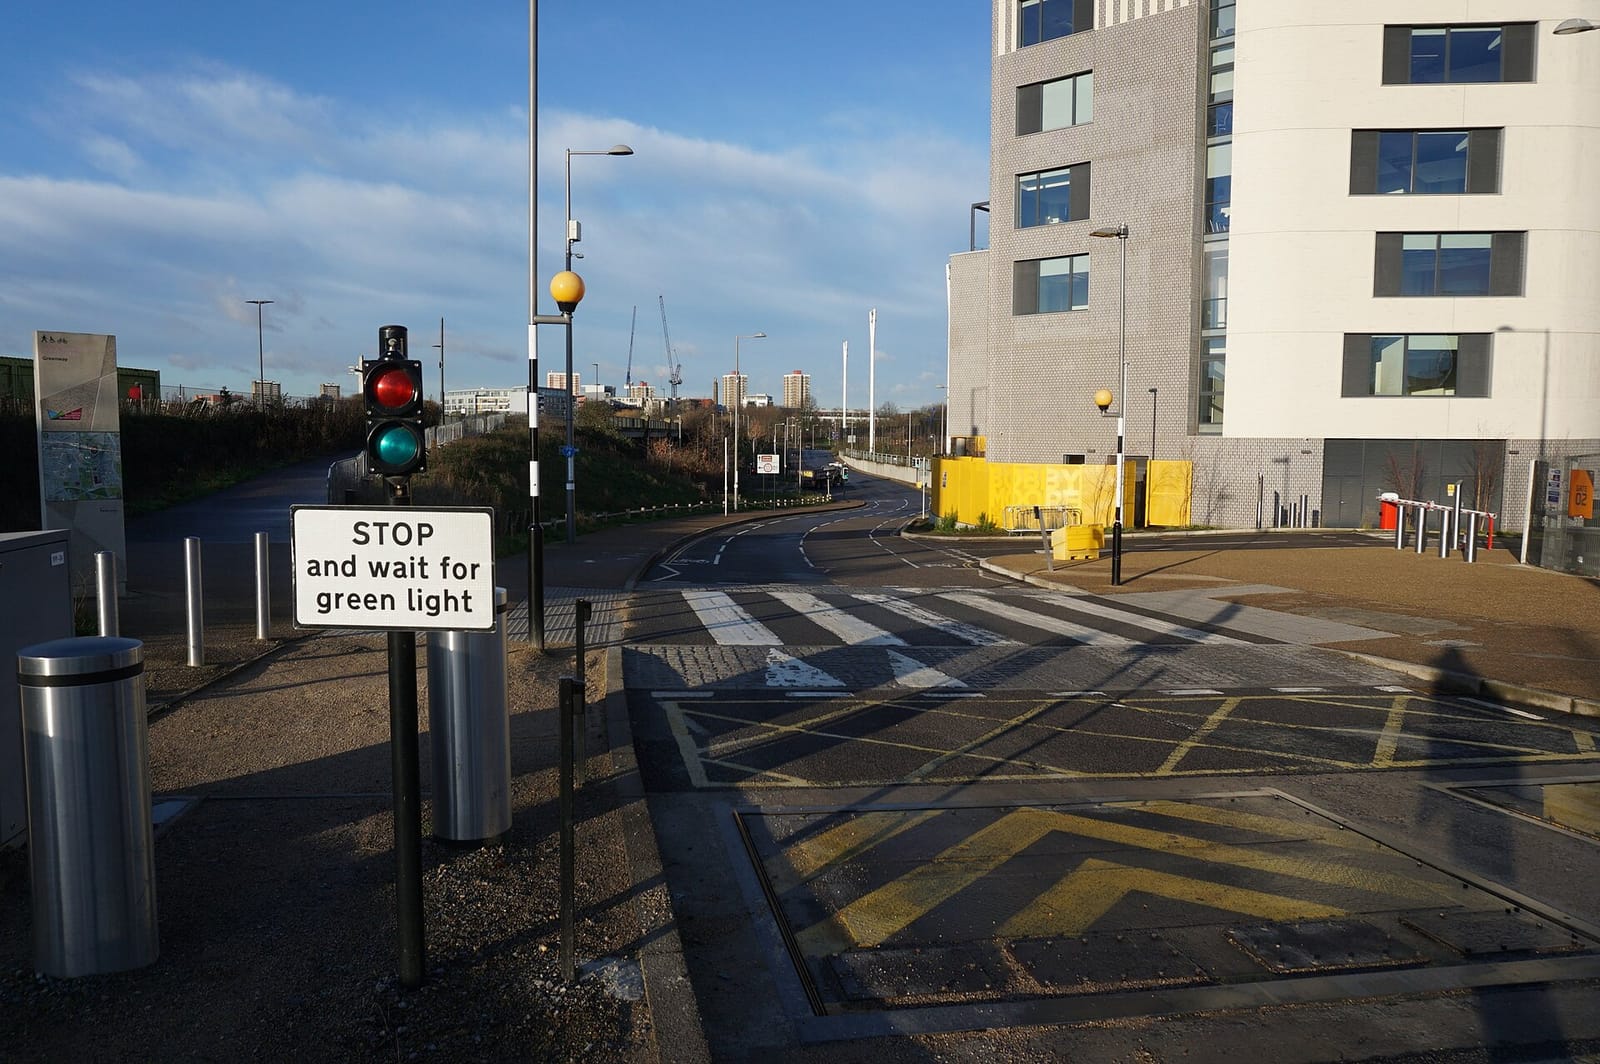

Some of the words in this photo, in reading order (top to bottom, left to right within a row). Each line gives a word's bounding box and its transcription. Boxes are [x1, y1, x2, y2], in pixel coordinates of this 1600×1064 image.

[1575, 492, 1587, 506] 02
[352, 521, 434, 546] STOP
[307, 554, 356, 577] and
[368, 556, 429, 579] wait
[440, 556, 480, 580] for
[316, 591, 395, 614] green
[407, 588, 473, 617] light
